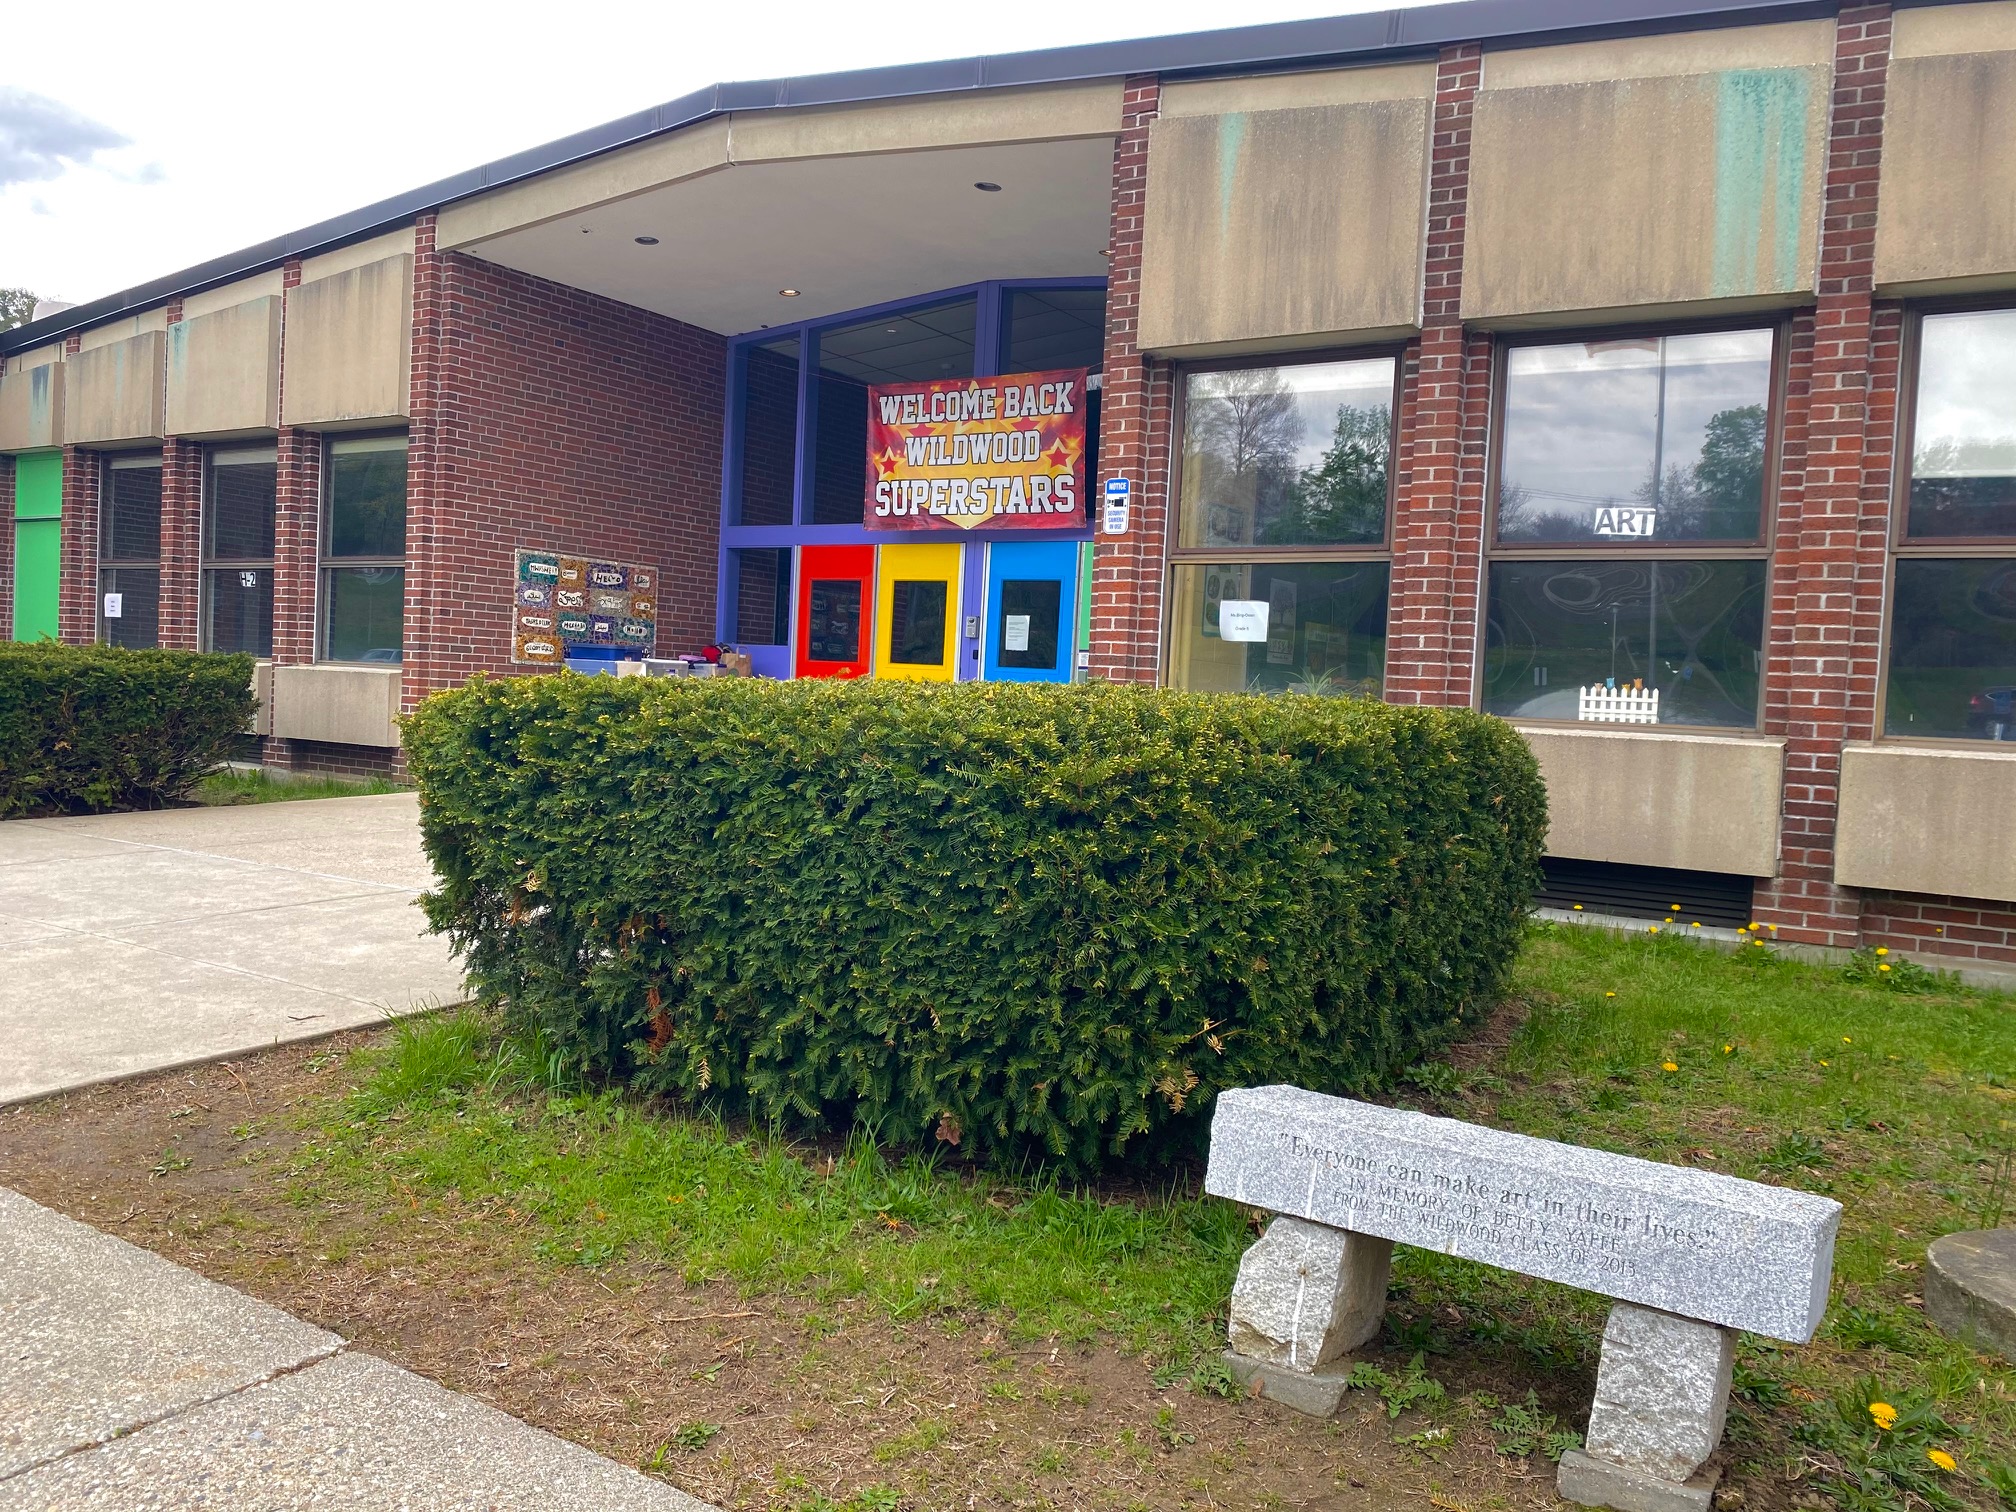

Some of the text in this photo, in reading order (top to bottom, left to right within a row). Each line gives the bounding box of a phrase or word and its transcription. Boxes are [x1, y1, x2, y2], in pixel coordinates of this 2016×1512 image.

[879, 381, 1074, 425] WELCOME BACK
[906, 430, 1041, 467] WILDWOOD
[875, 474, 1076, 517] SUPERSTARS
[1108, 482, 1127, 490] NOTICE
[1594, 509, 1656, 535] ART
[1350, 1177, 1367, 1192] IN
[1380, 1185, 1451, 1212] MEMORY
[1462, 1203, 1481, 1220] OF
[1493, 1210, 1551, 1236] BETTY
[1387, 1164, 1421, 1183] can
[1433, 1174, 1489, 1199] make
[1501, 1189, 1536, 1208] art
[1544, 1193, 1563, 1216] in
[1577, 1202, 1631, 1230] their
[1333, 1191, 1636, 1278] FROM THE WILDWOOD CLASS OF 2013
